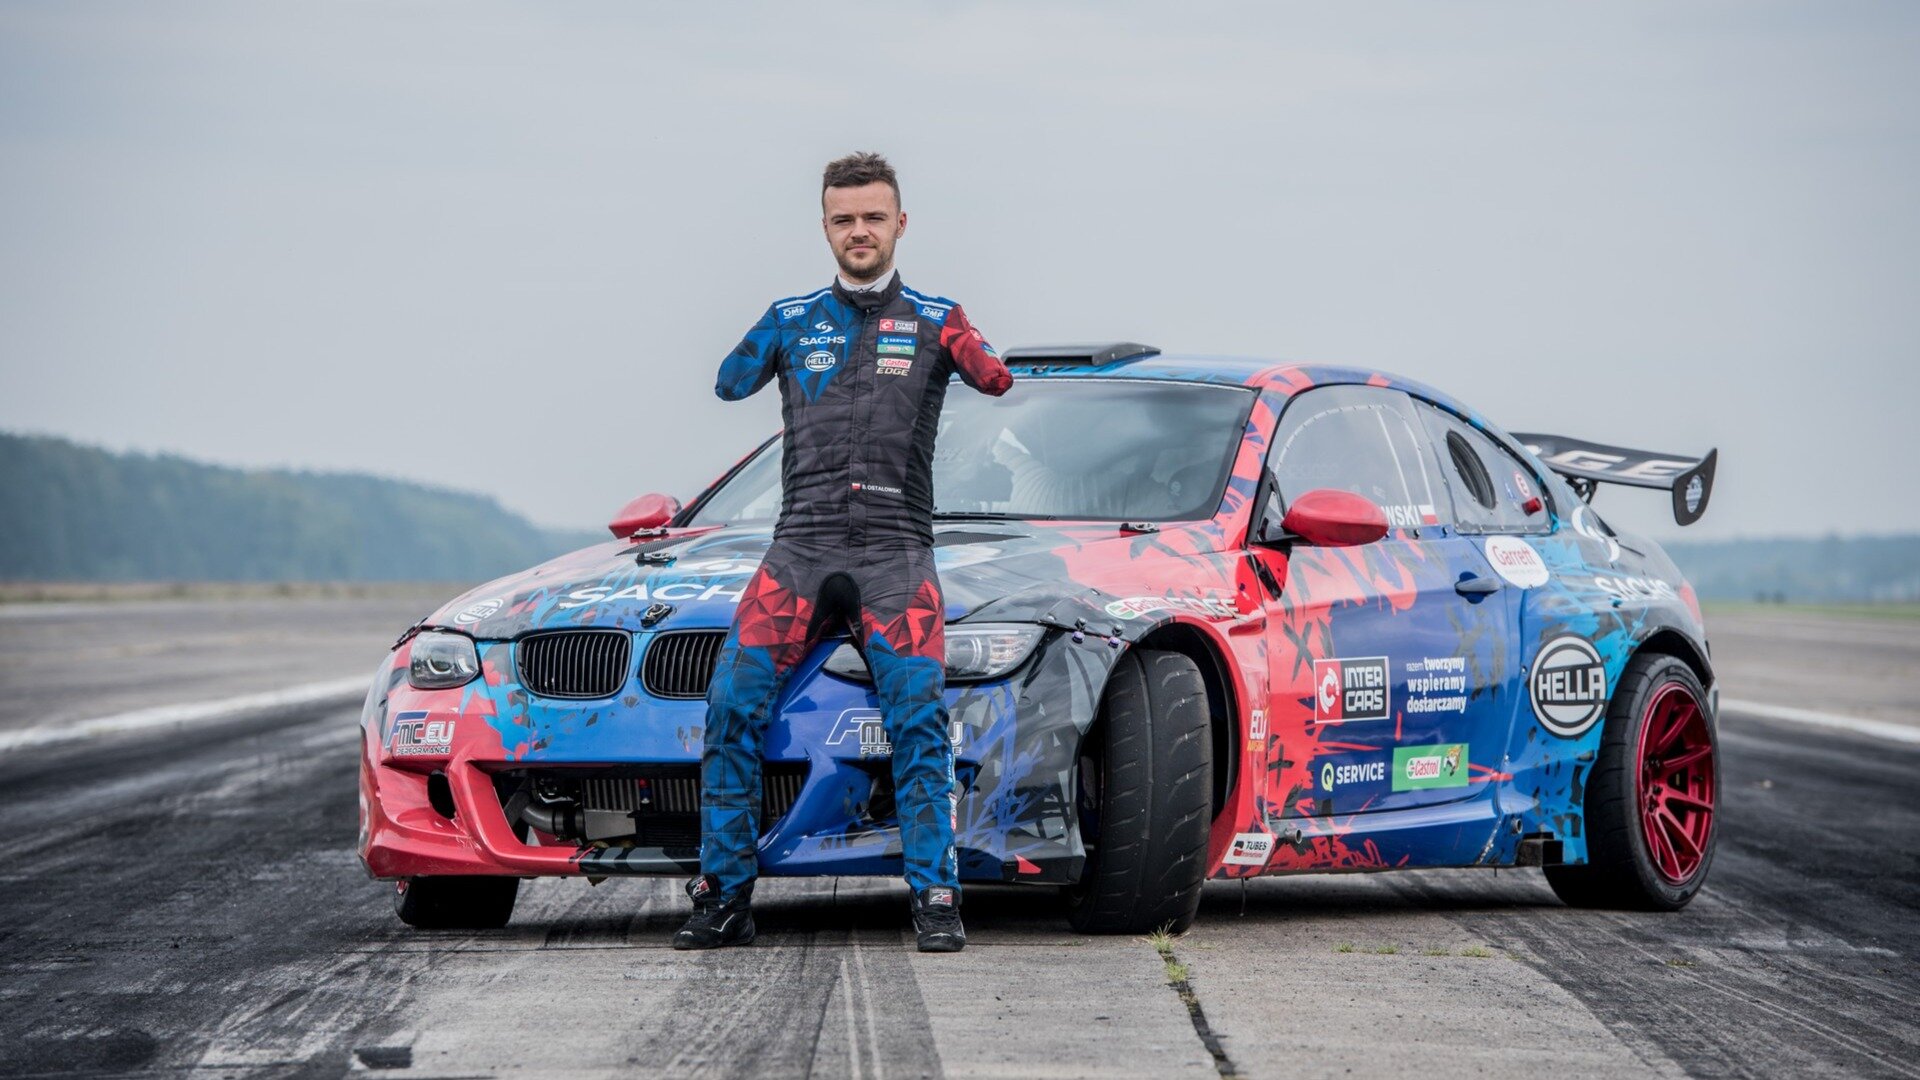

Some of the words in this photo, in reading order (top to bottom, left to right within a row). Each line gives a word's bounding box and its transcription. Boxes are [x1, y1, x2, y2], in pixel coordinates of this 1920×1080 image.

[782, 307, 805, 318] OMP
[799, 335, 846, 346] SACHS
[807, 357, 835, 365] HELLA
[885, 359, 910, 368] Castrol
[876, 367, 910, 377] EDGE
[1491, 544, 1537, 567] Garrett
[558, 583, 748, 609] SACH
[1594, 576, 1680, 601] SACHS
[1406, 662, 1424, 671] razem
[1423, 657, 1465, 673] tworzymy
[1344, 665, 1384, 689] INTER
[1407, 672, 1466, 696] wspieramy
[1538, 667, 1606, 701] HELLA
[1344, 689, 1384, 712] CARS
[1407, 695, 1467, 714] dostarczamy
[396, 746, 451, 756] PERFORMANCE
[1336, 762, 1385, 785] SERVICE
[1414, 757, 1440, 776] Castrol
[1246, 841, 1268, 851] TUBES
